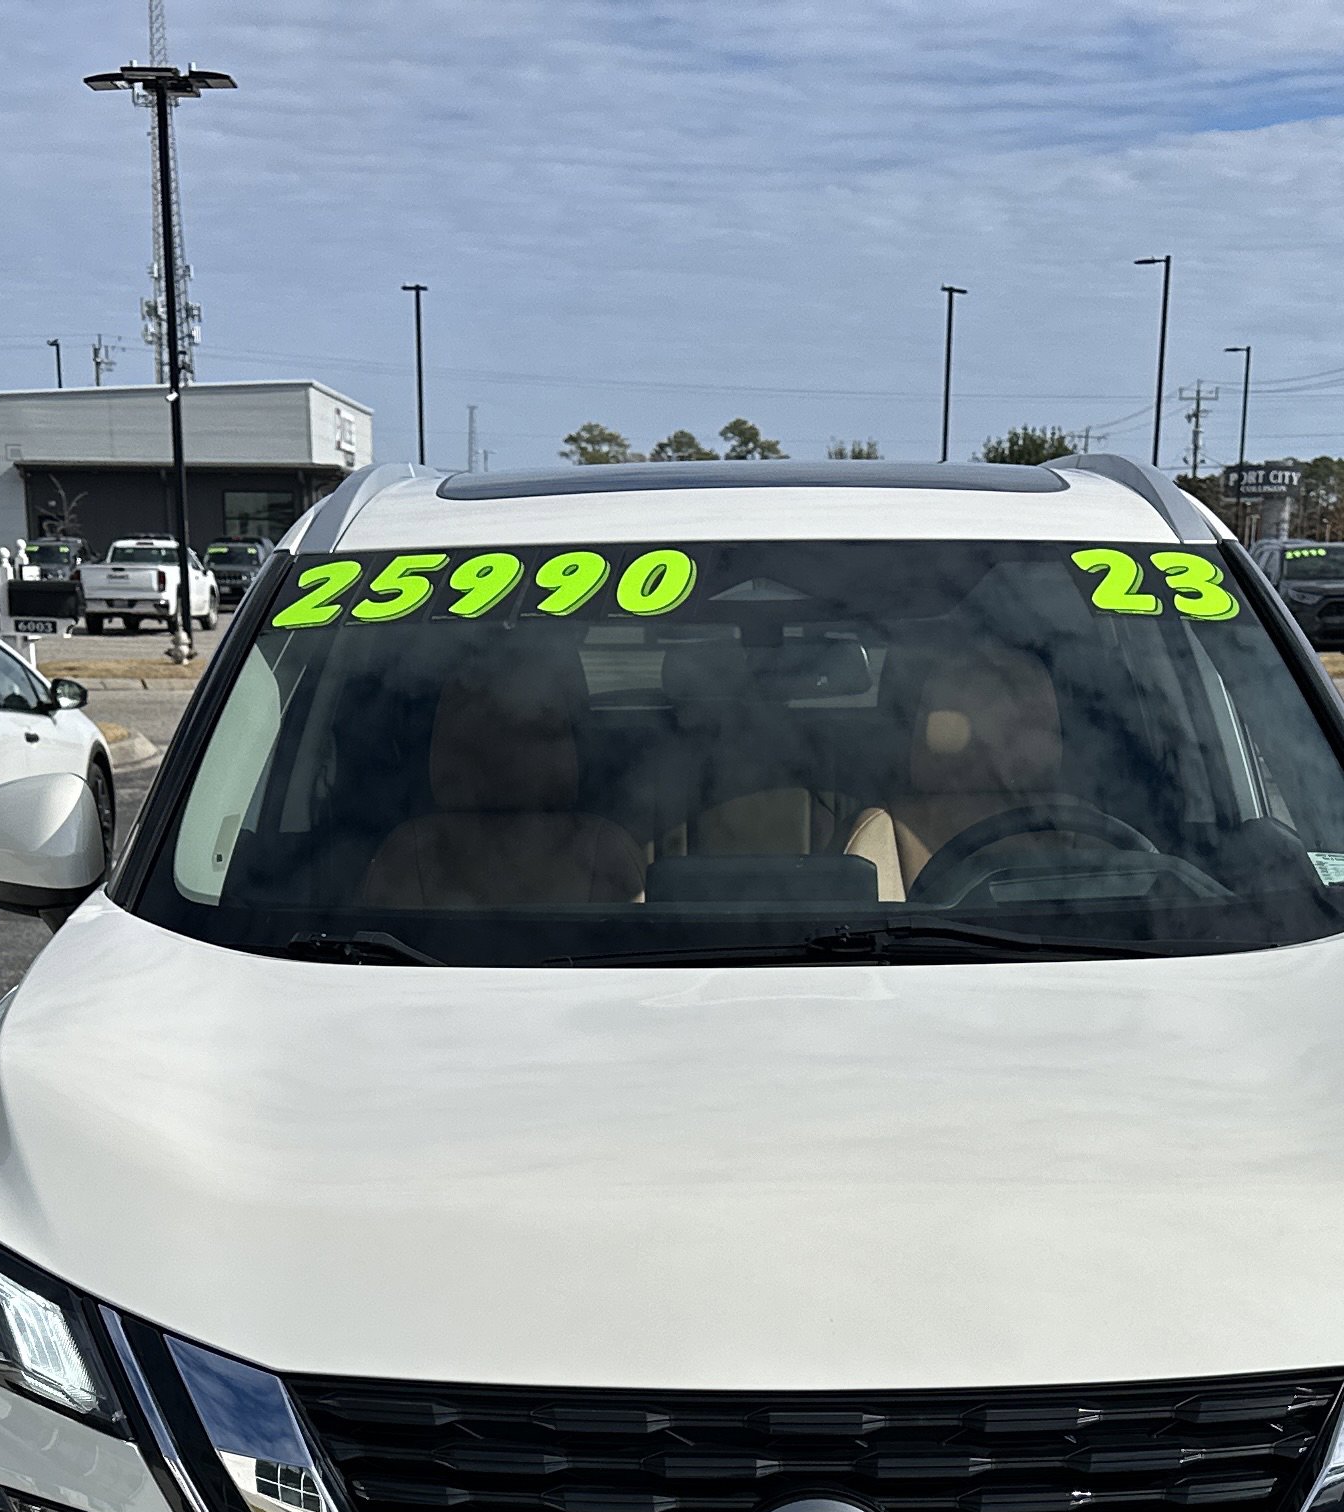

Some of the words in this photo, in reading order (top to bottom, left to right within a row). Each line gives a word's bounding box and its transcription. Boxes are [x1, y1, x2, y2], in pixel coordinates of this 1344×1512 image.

[1269, 470, 1302, 486] CITY
[271, 549, 697, 630] 25990
[1071, 548, 1241, 622] 23
